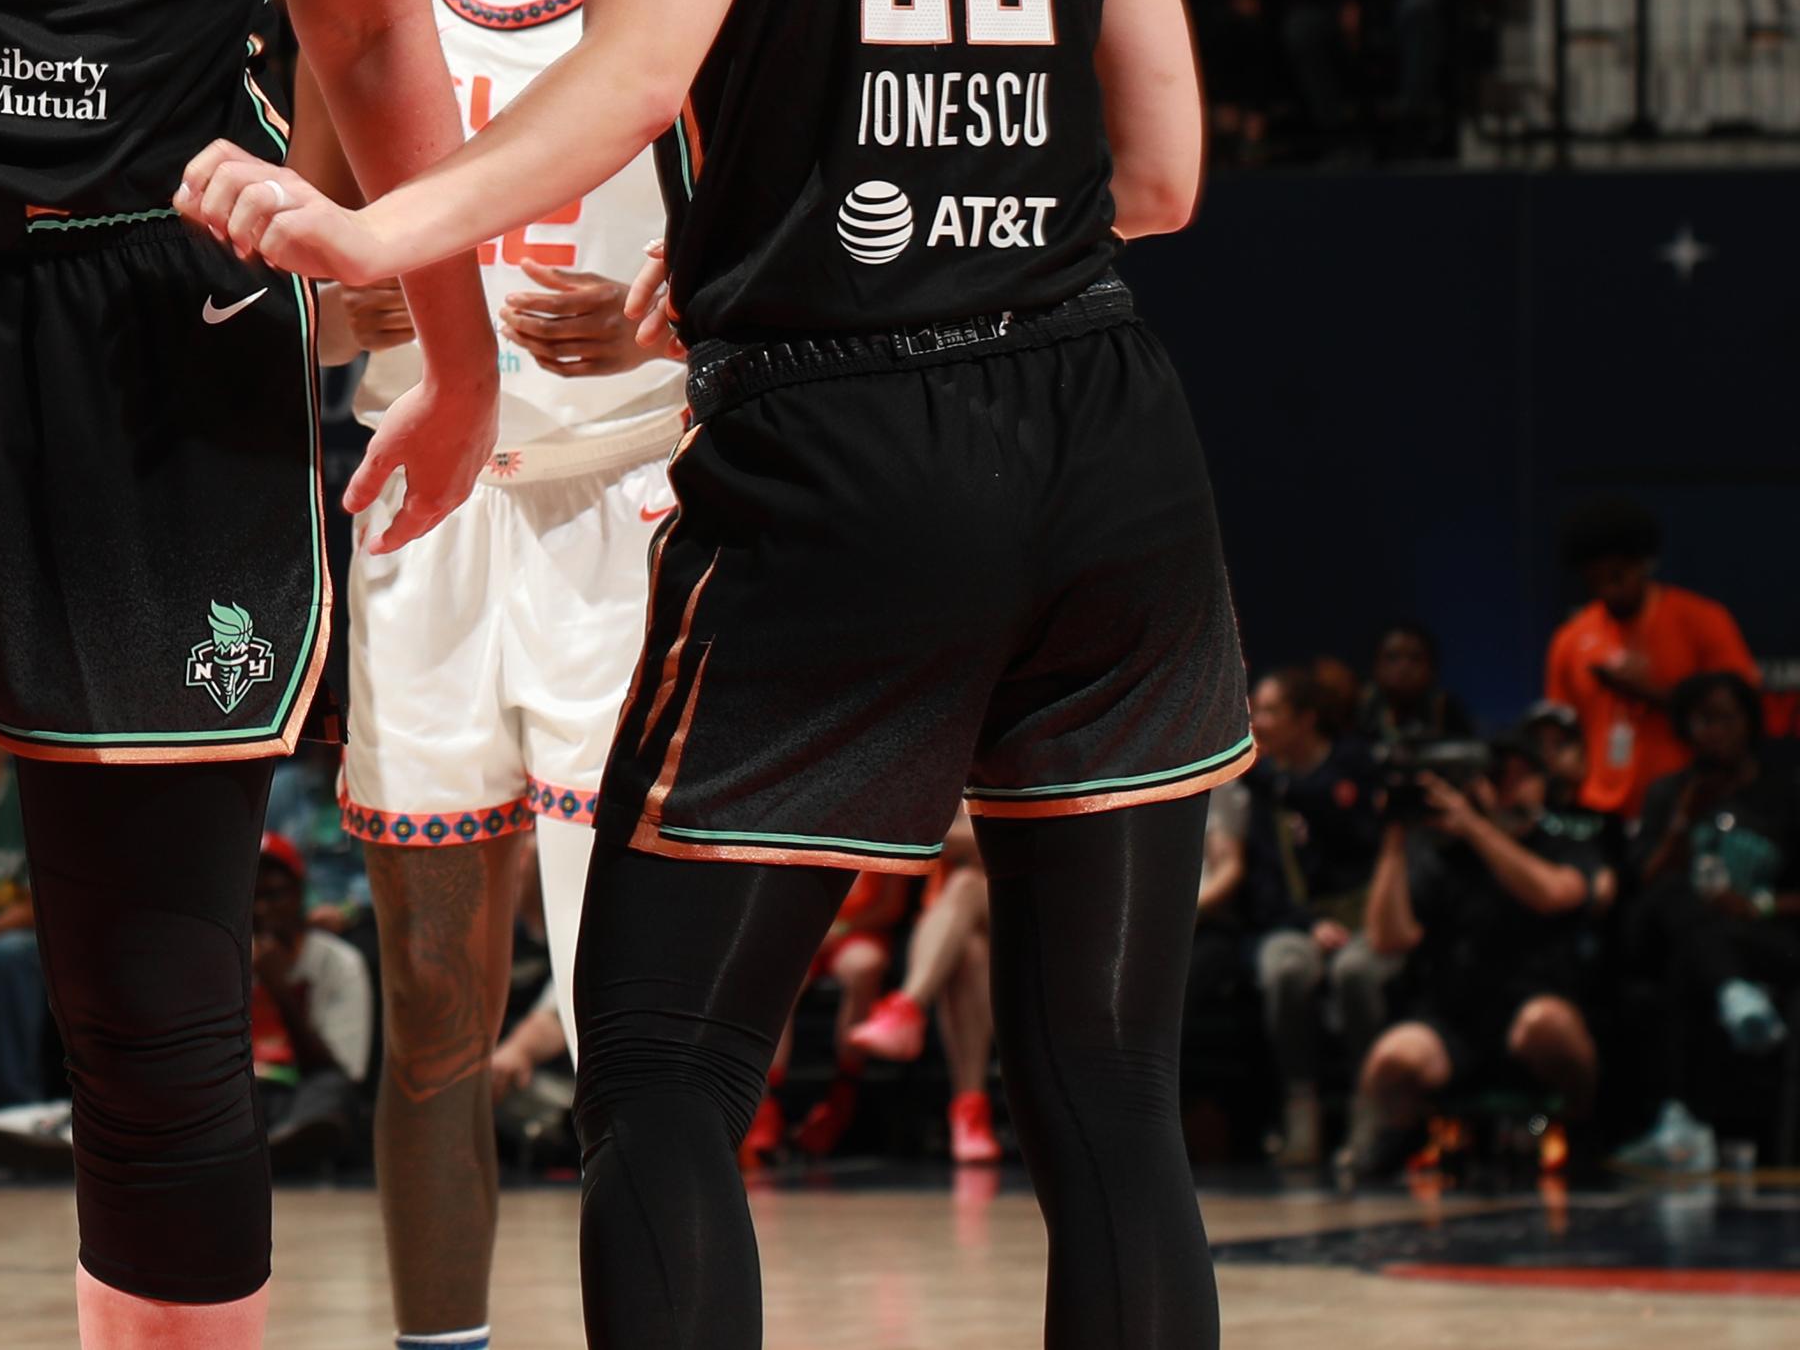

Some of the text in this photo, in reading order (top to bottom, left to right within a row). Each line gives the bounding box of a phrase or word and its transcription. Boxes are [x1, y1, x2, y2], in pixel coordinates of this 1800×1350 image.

[858, 71, 1048, 147] IONESCU
[927, 196, 1058, 248] AT&T
[194, 662, 213, 680] N
